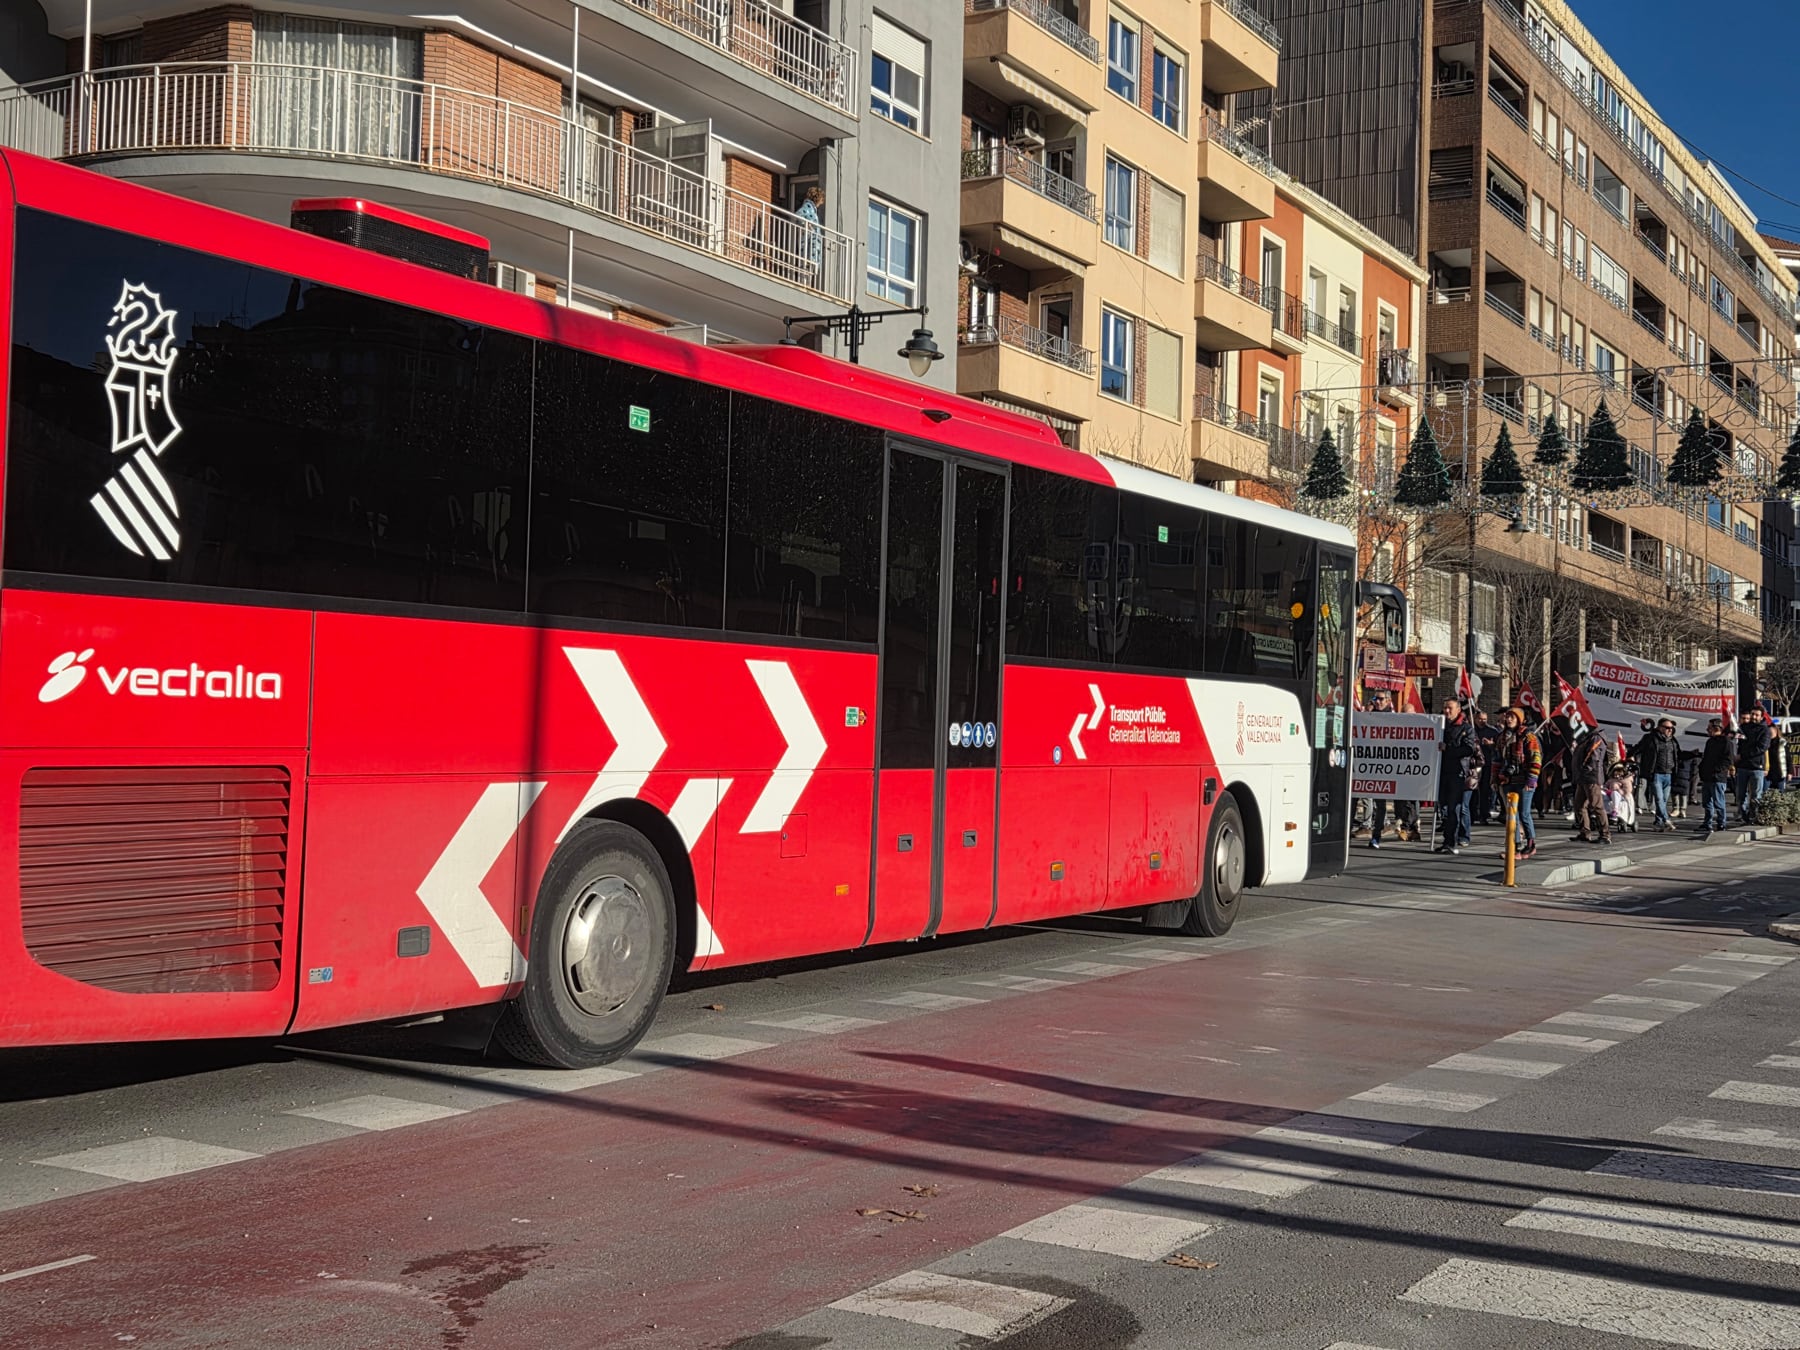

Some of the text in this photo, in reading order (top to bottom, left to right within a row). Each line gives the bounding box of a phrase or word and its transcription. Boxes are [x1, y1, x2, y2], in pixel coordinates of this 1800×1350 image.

[97, 663, 281, 699] vectalia
[1592, 664, 1616, 679] PELS
[1617, 669, 1648, 685] DRETS
[1587, 684, 1733, 712] UNIM LA CLASSE TREBALLADOA
[1109, 705, 1166, 724] Transport Públic
[1246, 714, 1283, 728] GENERALITAT
[1561, 700, 1589, 739] CGT
[1109, 726, 1181, 743] Generalitat Valenciana
[1247, 730, 1282, 743] VALENCIANA
[1361, 726, 1367, 739] Y
[1370, 726, 1435, 740] EXPEDIENTA
[1358, 763, 1393, 775] OTRO
[1396, 764, 1431, 776] LADO
[1354, 780, 1391, 792] DIGNA
